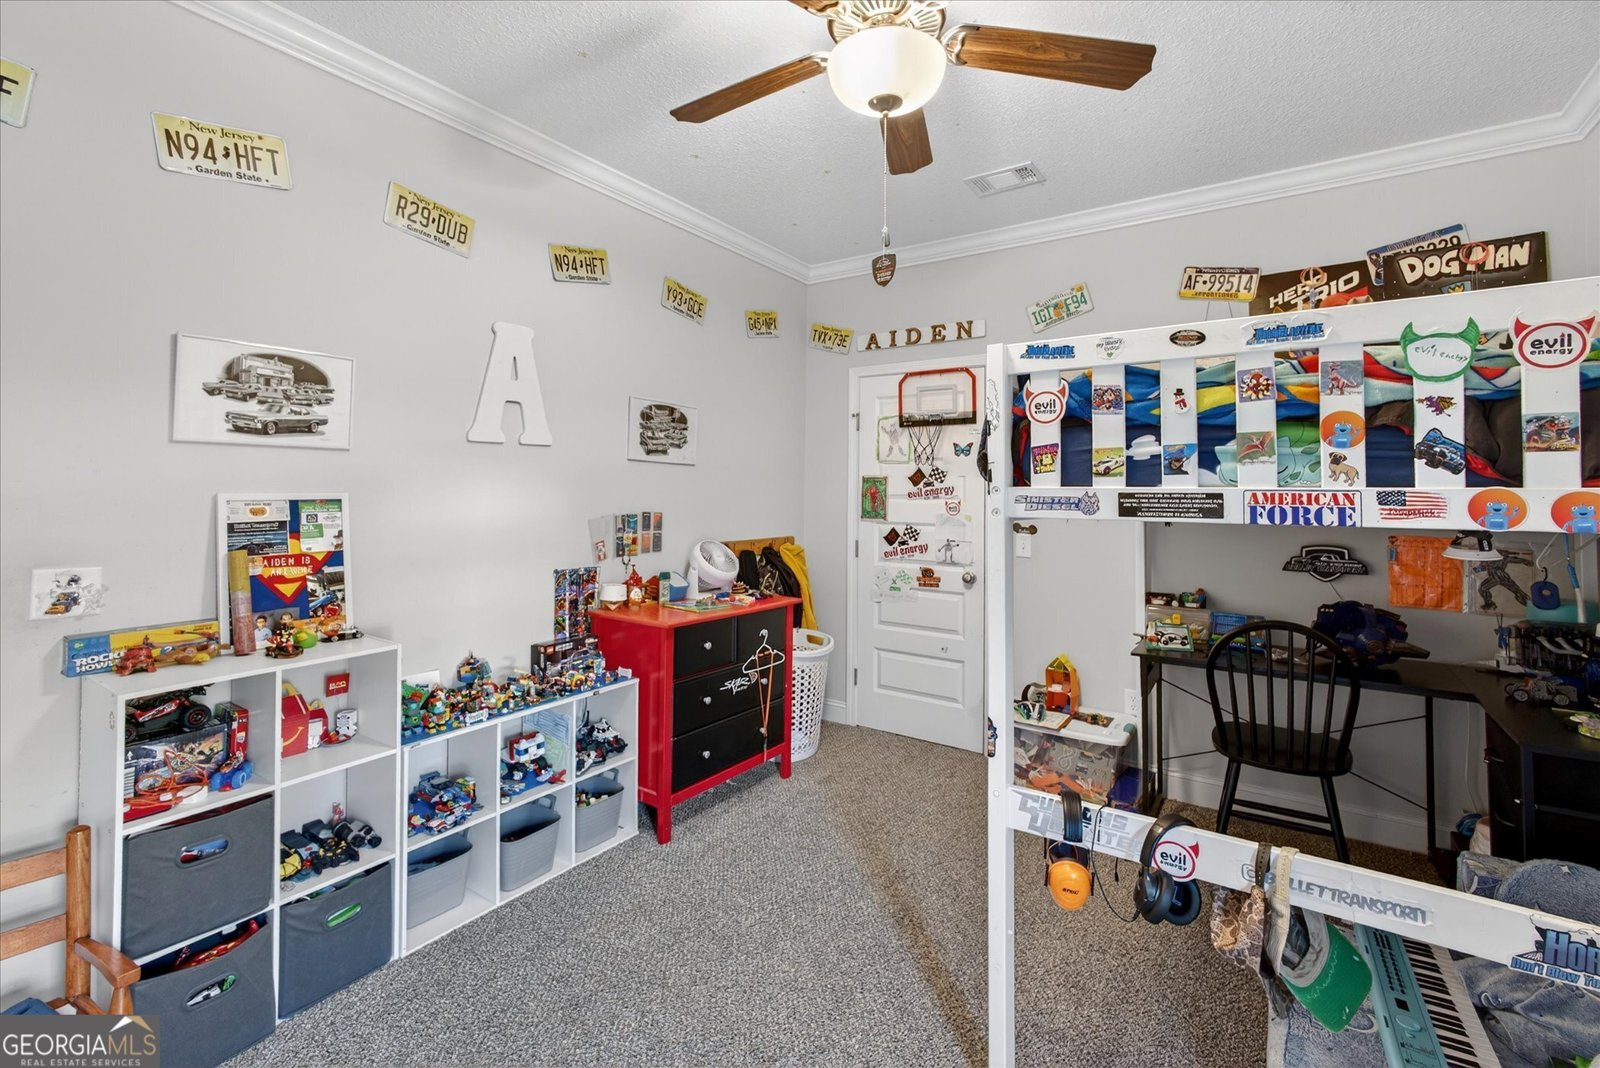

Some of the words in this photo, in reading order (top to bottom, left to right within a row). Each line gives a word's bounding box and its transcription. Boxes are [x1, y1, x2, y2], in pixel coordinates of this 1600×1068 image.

[189, 121, 217, 136] New
[220, 128, 256, 143] Jersey
[164, 128, 218, 166] N94
[233, 142, 279, 176] HFT
[195, 164, 233, 178] Garden
[235, 171, 263, 183] State
[395, 194, 432, 228] R29
[436, 213, 469, 245] DUB
[554, 253, 579, 273] N94
[584, 256, 605, 275] HFT
[1398, 249, 1461, 284] DOG
[1466, 240, 1531, 272] MAN
[865, 320, 974, 350] AIDEN
[1530, 332, 1573, 350] evil
[1529, 347, 1574, 356] energy
[1034, 399, 1057, 410] evil
[1248, 492, 1357, 506] AMERICAN
[1248, 505, 1357, 527] FORCE
[1160, 851, 1187, 866] evil
